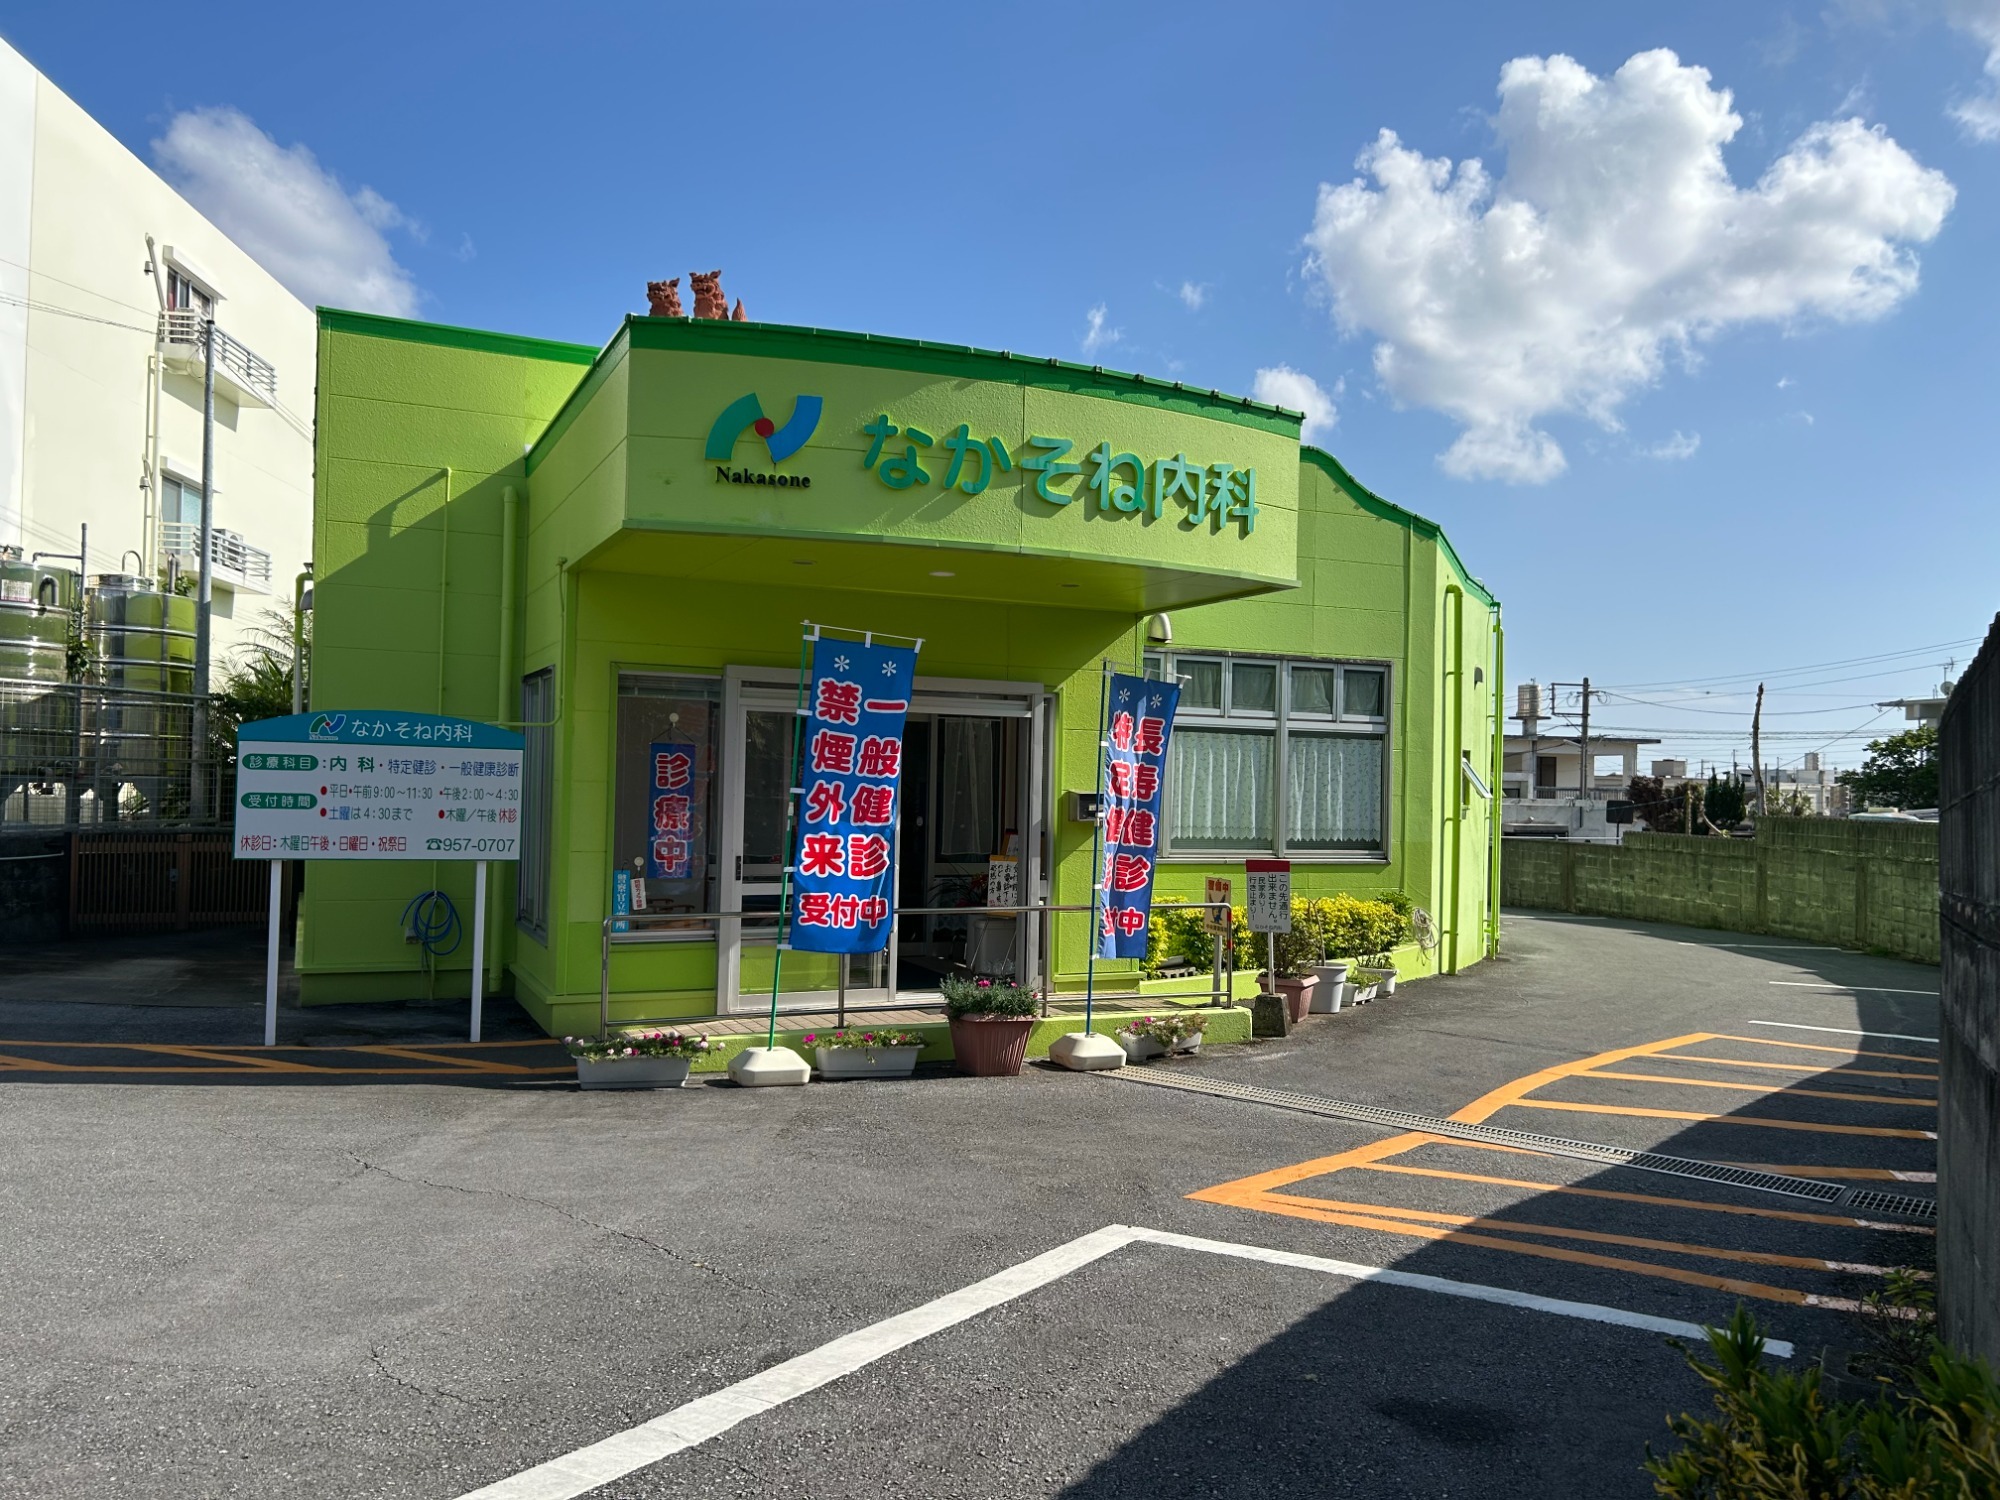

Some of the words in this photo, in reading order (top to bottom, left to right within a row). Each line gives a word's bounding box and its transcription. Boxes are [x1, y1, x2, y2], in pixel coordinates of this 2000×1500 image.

[715, 466, 811, 488] Nakasone
[863, 414, 1259, 534] なかそね内科
[351, 719, 473, 743] なかそね内科
[249, 755, 311, 769] 診療科目
[800, 677, 862, 878] 禁煙外来
[248, 794, 311, 808] 受付時間
[848, 699, 907, 880] 一般健診
[1114, 716, 1165, 892] 長寿健診
[653, 752, 691, 873] 診療中
[443, 837, 515, 852] 957-0707
[798, 891, 888, 929] 受付中
[1279, 874, 1289, 920] この先通行
